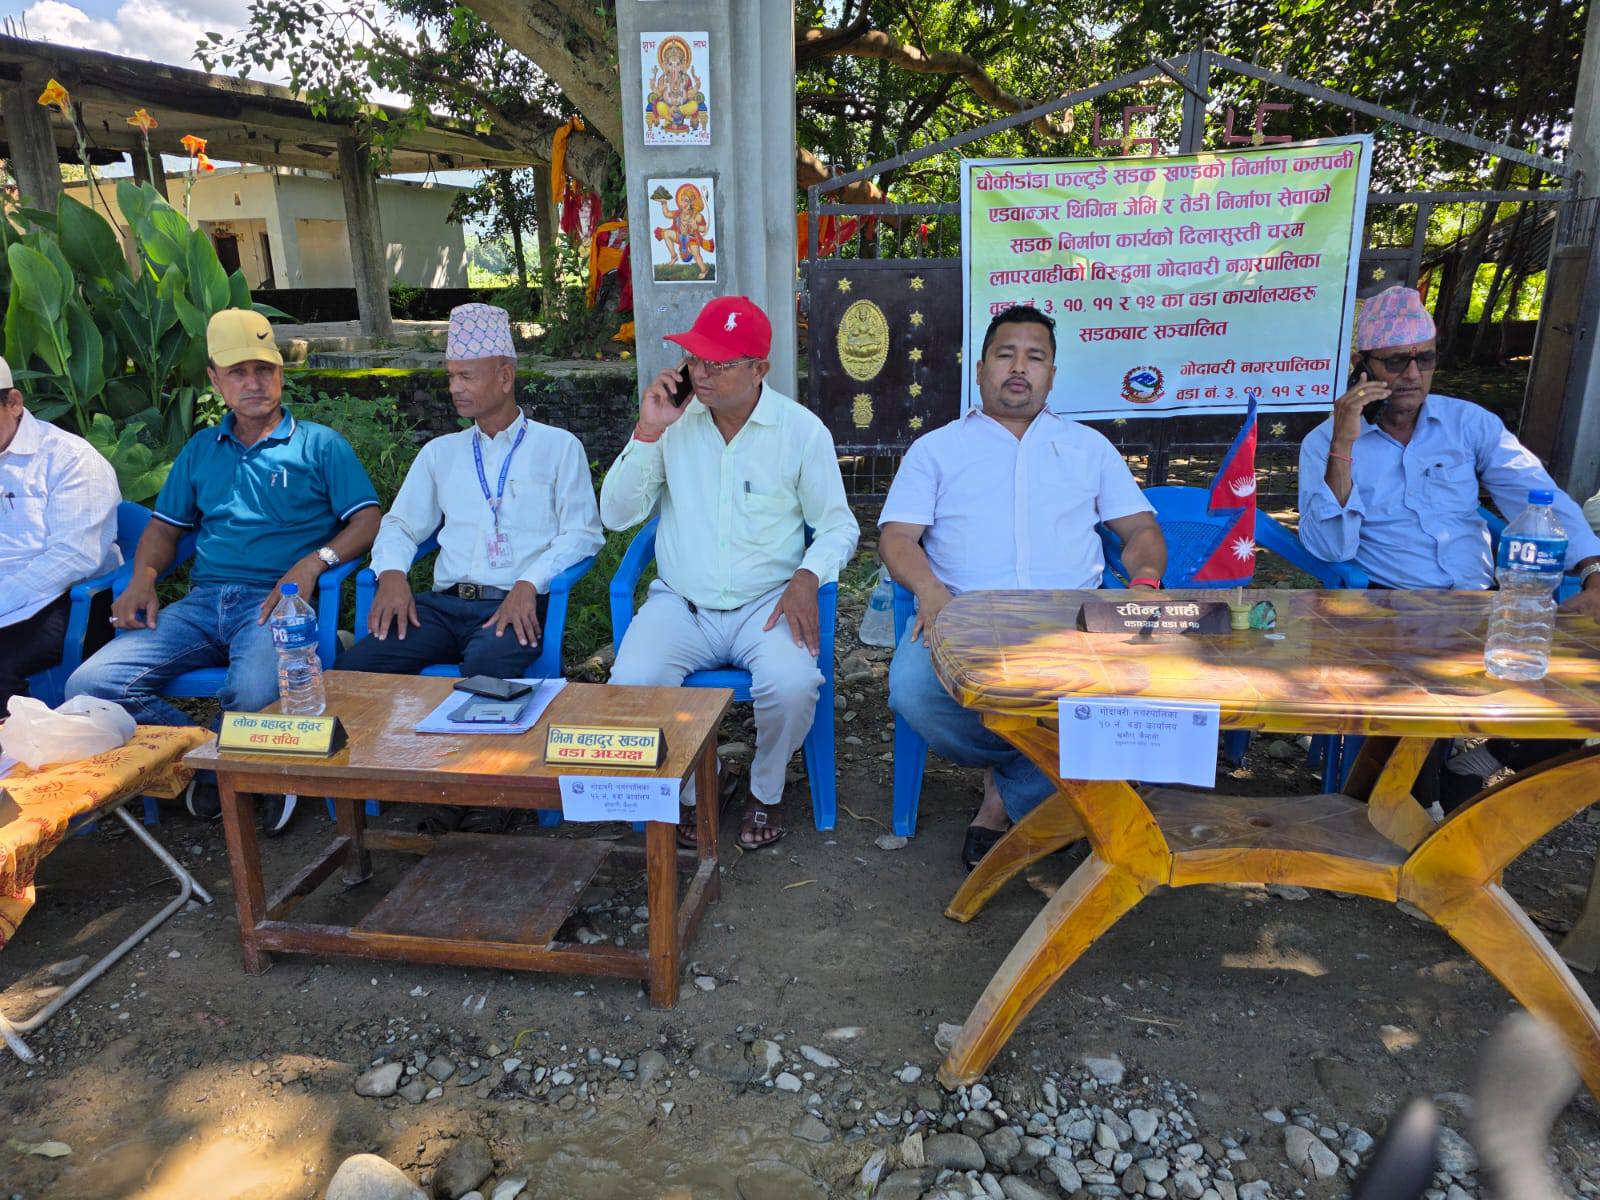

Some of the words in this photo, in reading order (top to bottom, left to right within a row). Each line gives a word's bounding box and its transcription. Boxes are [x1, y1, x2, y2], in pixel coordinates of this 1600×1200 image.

[1113, 168, 1157, 186] सडक
[1163, 158, 1226, 182] खण्डको
[1231, 156, 1288, 177] निर्माण
[1293, 150, 1354, 173] कम्पनी
[1122, 195, 1158, 216] जेभि
[1163, 199, 1177, 215] र
[1216, 190, 1272, 211] निर्माण
[1277, 183, 1332, 208] सेवाको
[1010, 237, 1054, 254] सडक
[1058, 232, 1112, 251] निर्माण
[1116, 226, 1174, 248] कार्यको
[1179, 222, 1262, 246] ढिलासुस्ती
[1267, 222, 1306, 239] चरम
[989, 264, 1086, 286] लापरवाहीको
[1157, 256, 1222, 277] गोदावरी
[1225, 250, 1322, 272] नगरपालिका
[1093, 296, 1114, 312] ११
[1120, 296, 1132, 311] र
[1136, 296, 1156, 309] १२
[1161, 293, 1184, 308] का
[1189, 292, 1218, 307] वडा
[1079, 325, 1150, 343] सडकबाट
[1180, 358, 1236, 376] गोदावरी
[1240, 356, 1332, 374] नगरपालिका
[1176, 388, 1200, 400] वडा
[1272, 384, 1290, 398] ११
[1296, 384, 1307, 396] र
[1311, 384, 1330, 396] १२
[1508, 540, 1536, 564] PG
[1165, 603, 1200, 616] शाही
[272, 627, 288, 643] PG
[232, 716, 258, 728] लोक
[260, 719, 293, 732] बहादुर
[249, 734, 269, 744] वडा
[272, 733, 300, 746] सचिव
[550, 728, 574, 744] भिम
[577, 733, 614, 749] बहादुर
[618, 735, 656, 748] खडका
[558, 748, 586, 758] वडा
[592, 749, 644, 760] अध्यक्ष
